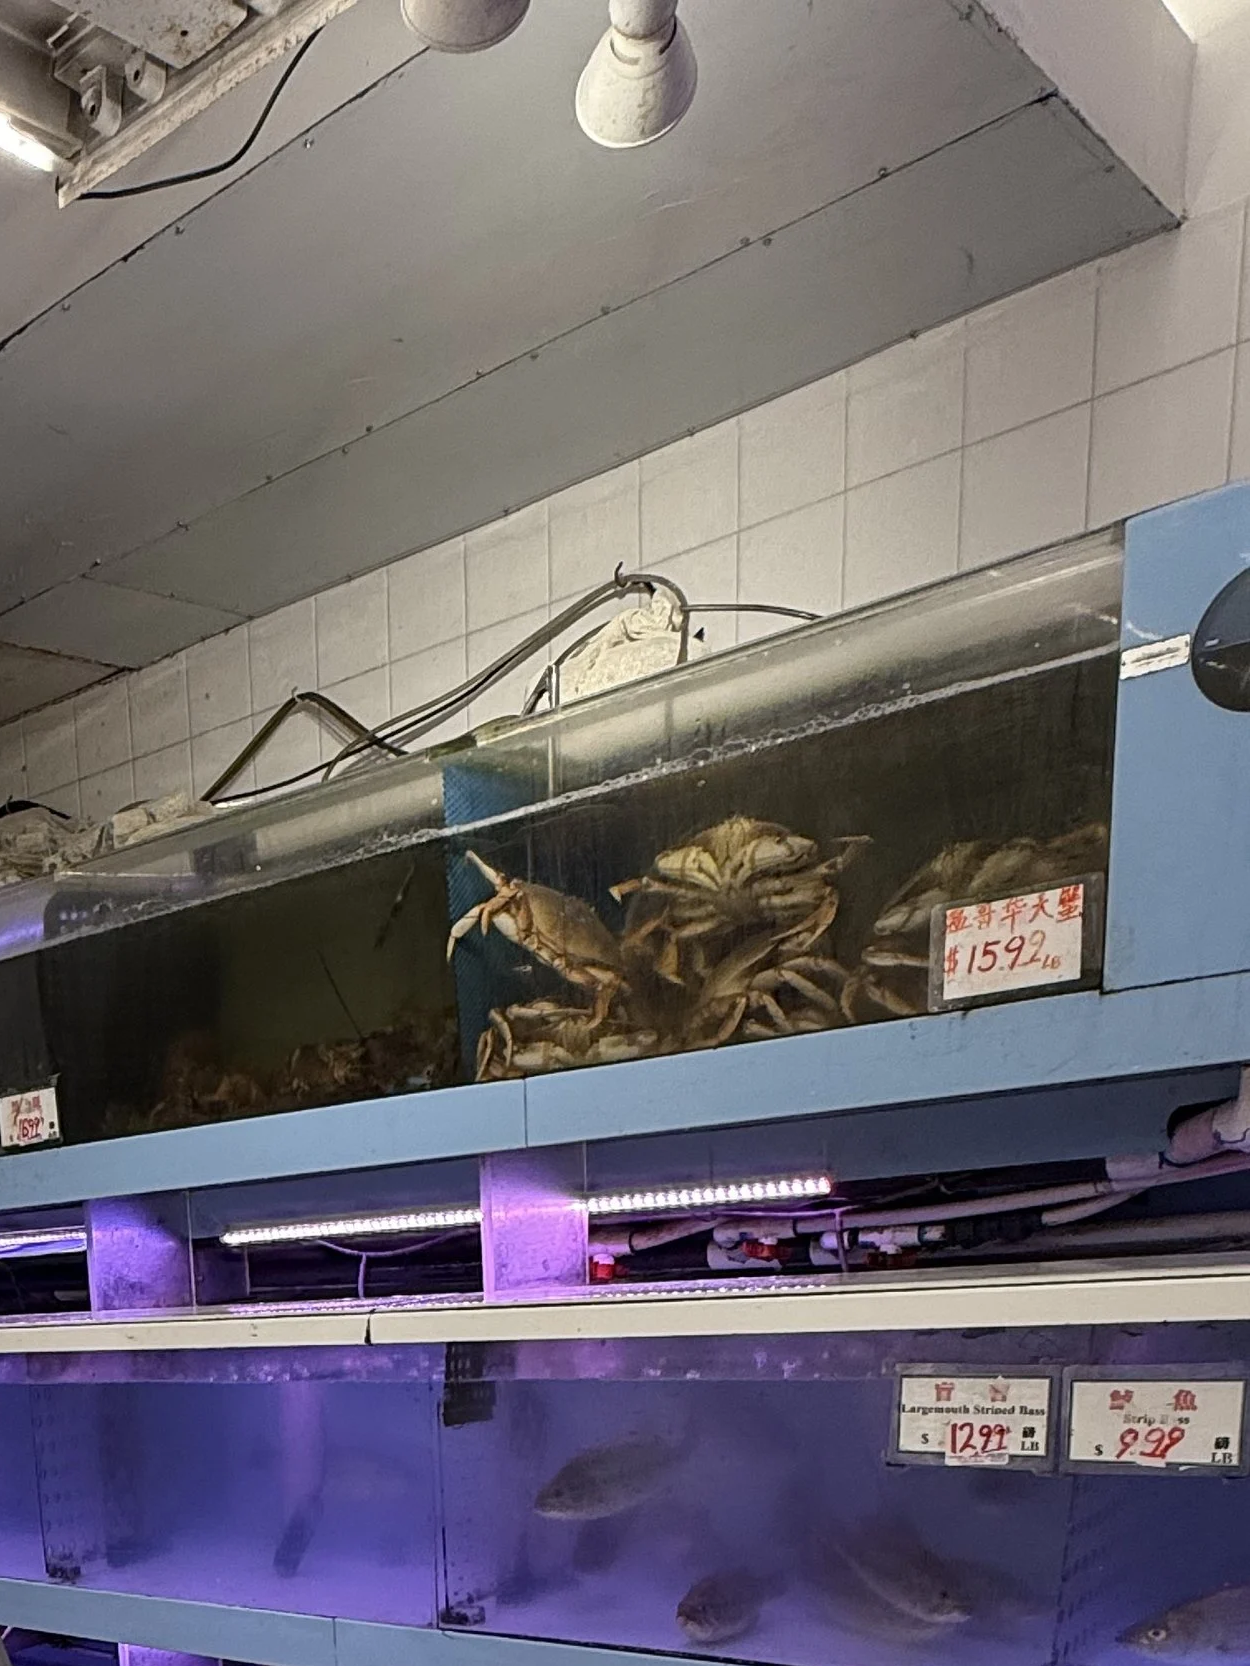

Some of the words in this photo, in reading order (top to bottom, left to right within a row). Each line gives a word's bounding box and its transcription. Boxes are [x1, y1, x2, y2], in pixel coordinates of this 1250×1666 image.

[901, 1403, 971, 1415] Largemouth
[1159, 1414, 1190, 1425] Bss
[1020, 1441, 1040, 1452] LB
[1211, 1452, 1234, 1465] LB
